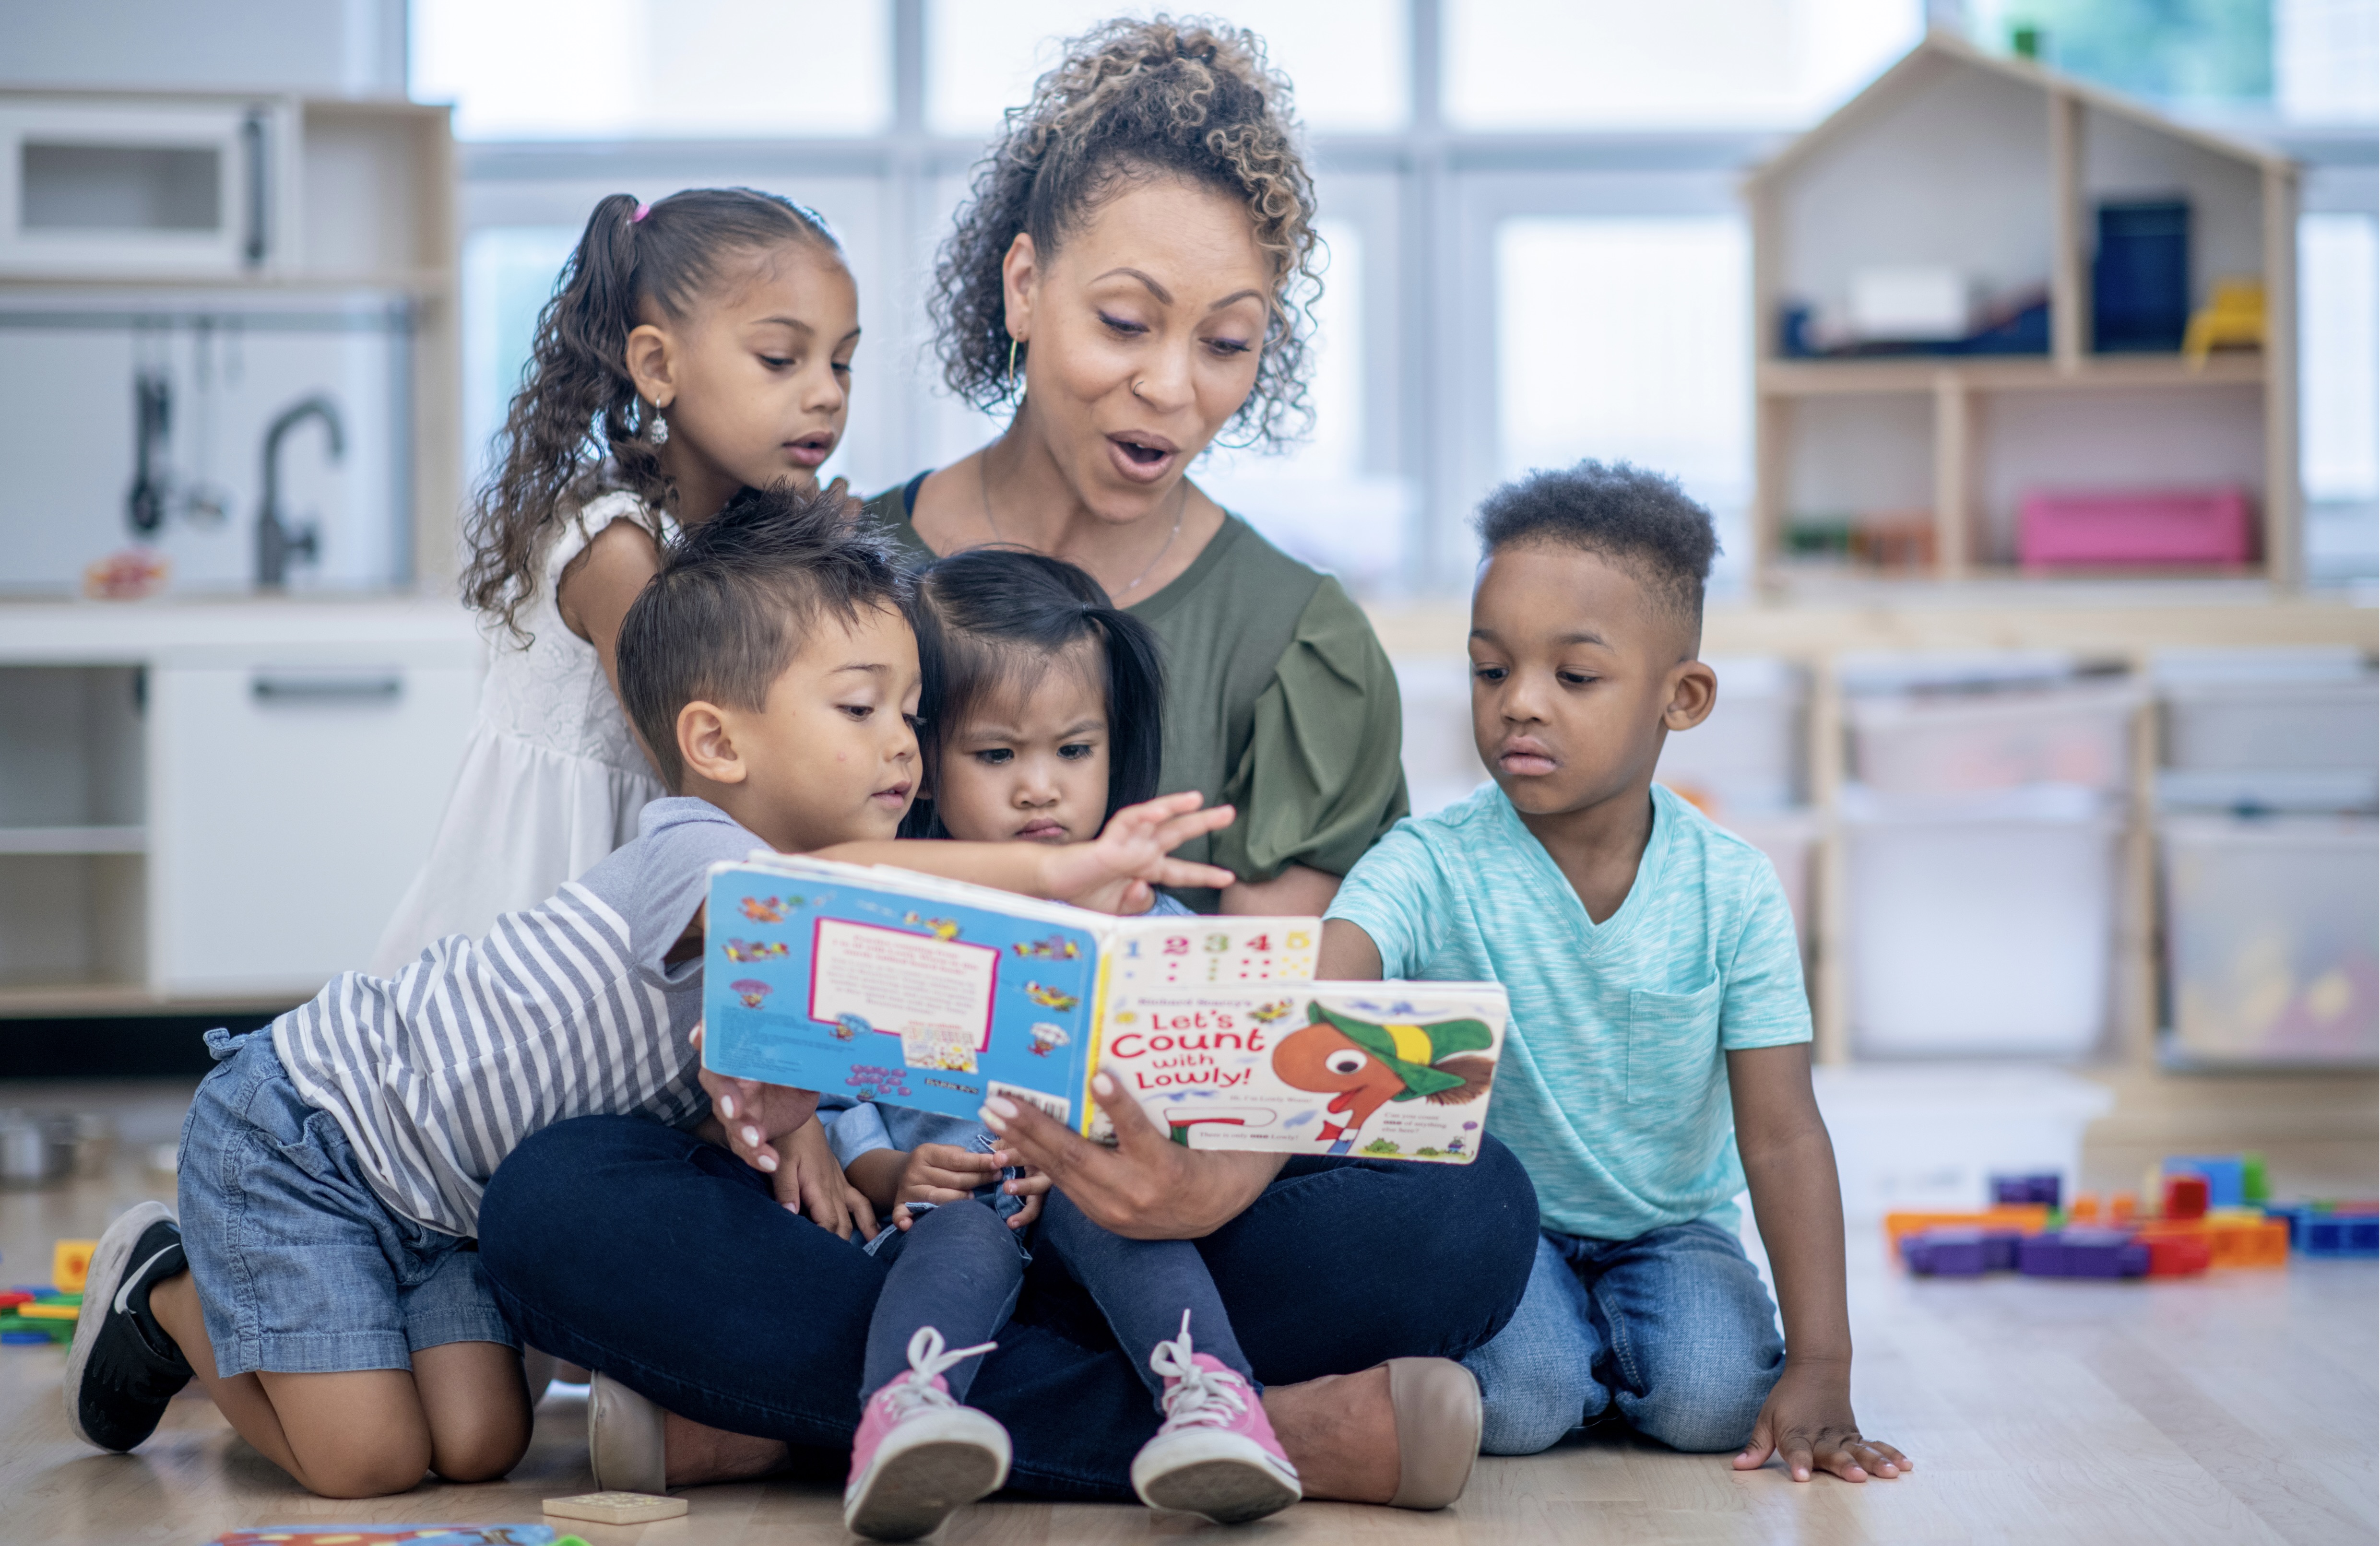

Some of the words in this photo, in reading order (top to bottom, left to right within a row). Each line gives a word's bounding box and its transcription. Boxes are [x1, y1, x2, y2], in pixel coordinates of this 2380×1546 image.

[1125, 938, 1140, 958] 1
[1163, 936, 1189, 956] 2
[1204, 934, 1230, 954] 3
[1245, 933, 1271, 952] 4
[1286, 931, 1310, 950] 5
[1151, 1009, 1234, 1030] Let's
[1111, 1028, 1265, 1058] Count
[1152, 1054, 1214, 1069] with
[1136, 1067, 1251, 1089] Lowly!
